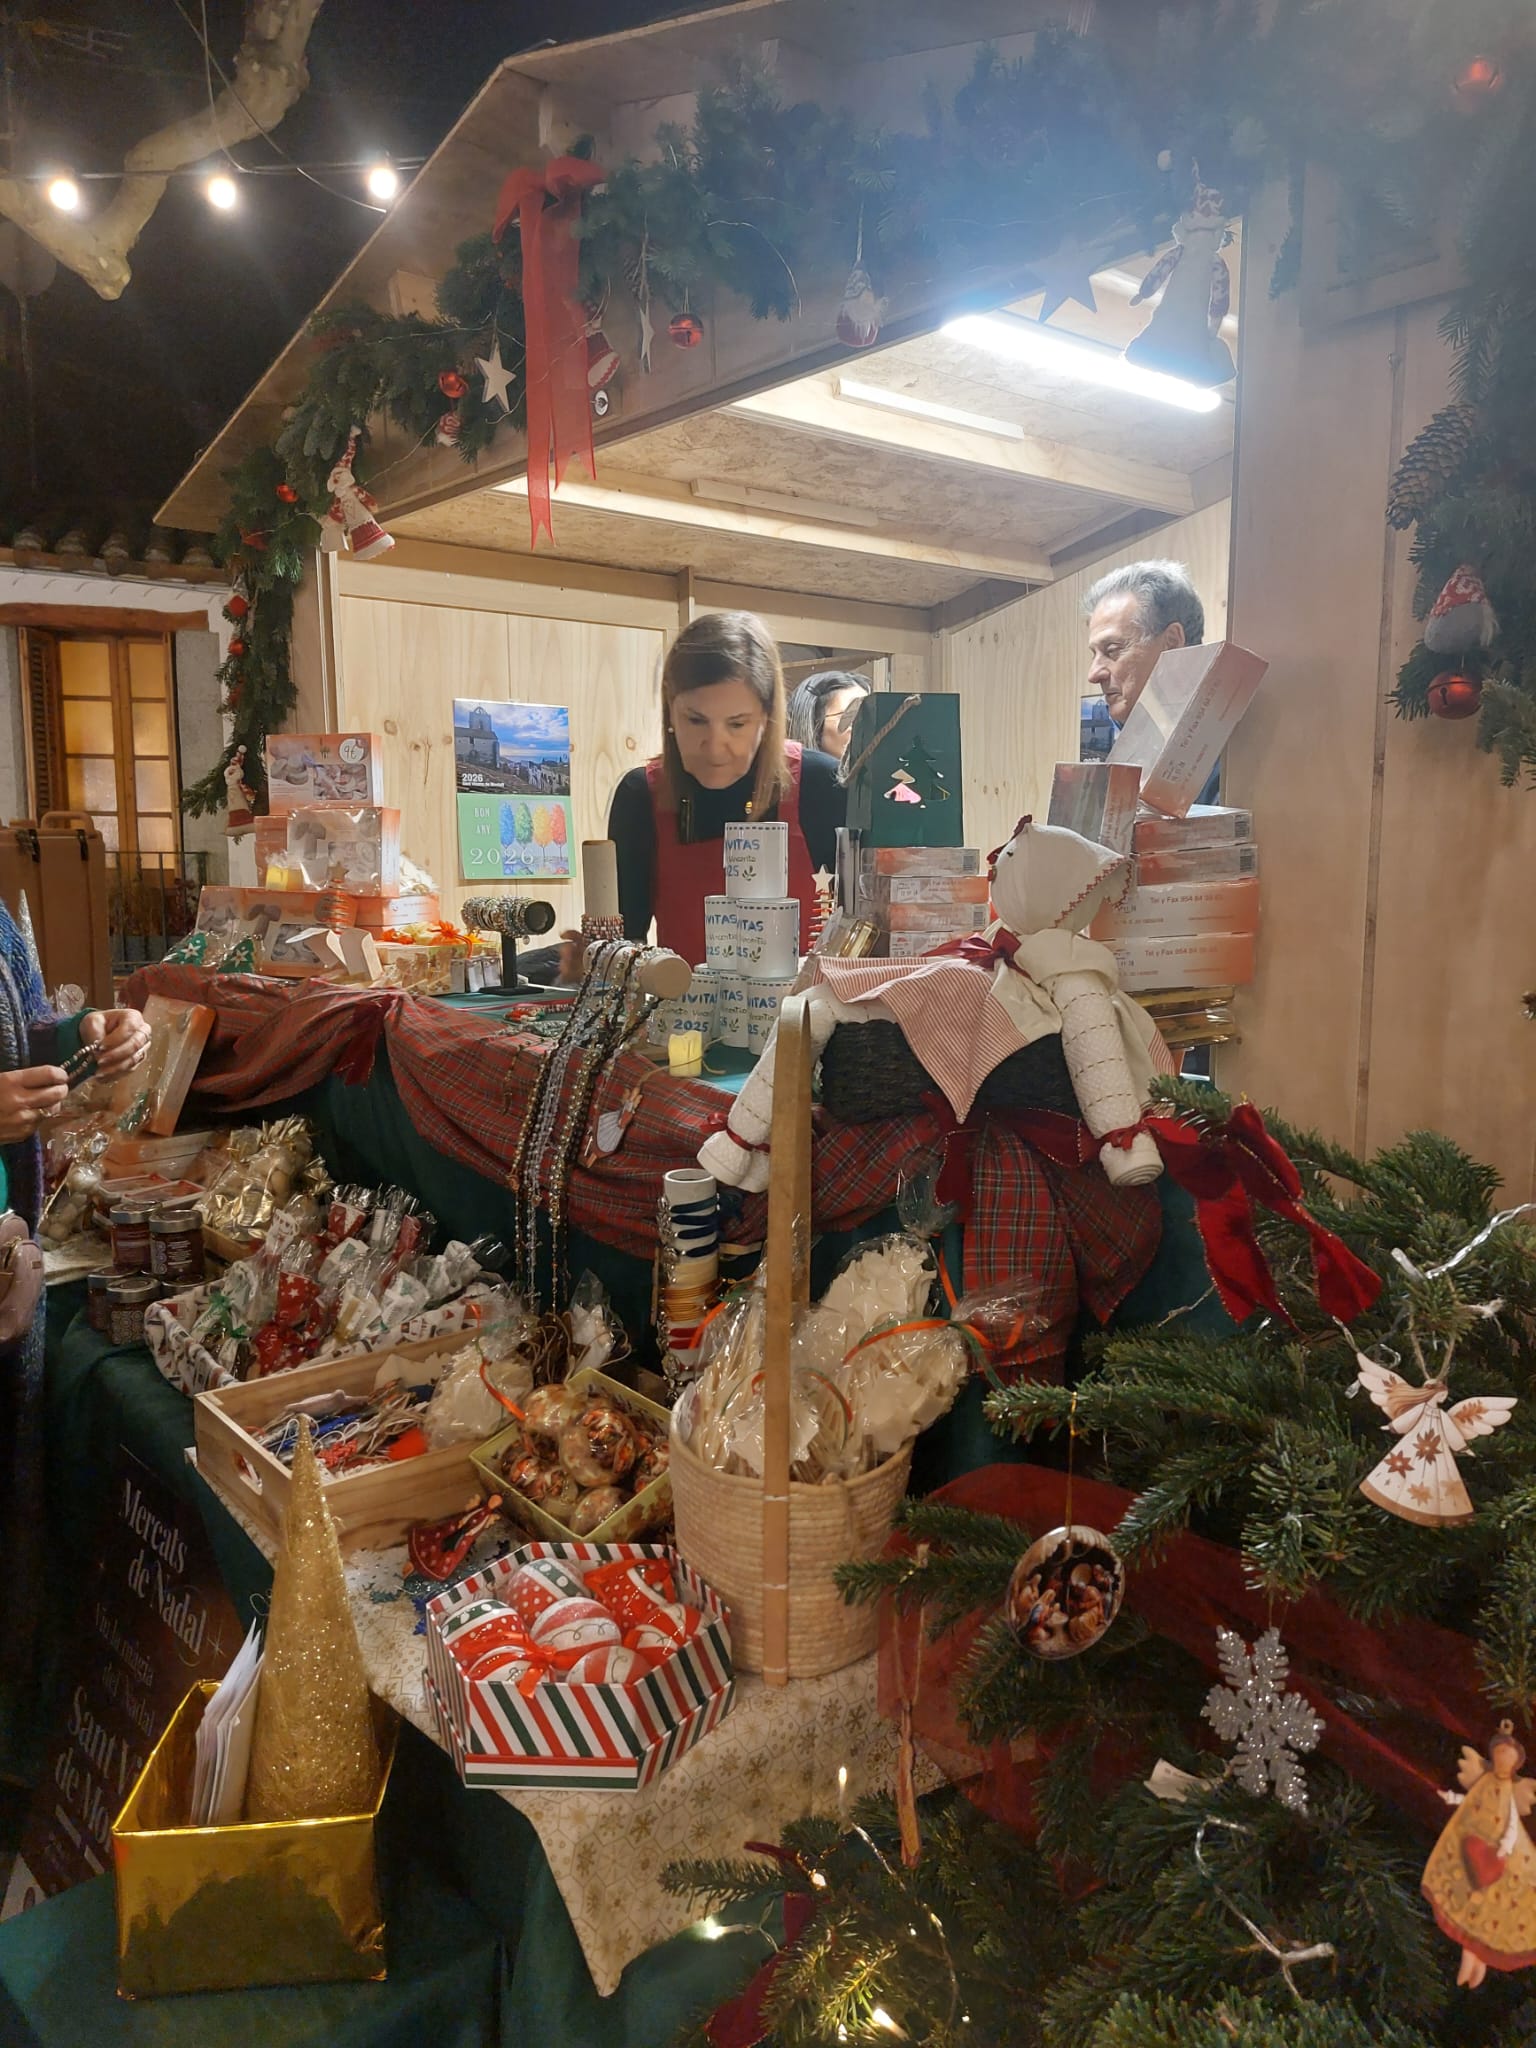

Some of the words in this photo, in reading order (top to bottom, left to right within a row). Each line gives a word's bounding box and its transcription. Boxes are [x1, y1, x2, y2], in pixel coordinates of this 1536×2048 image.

[462, 773, 484, 782] 2026
[470, 847, 534, 865] 2026
[727, 864, 739, 877] 25
[673, 1018, 709, 1033] 2025
[118, 1478, 188, 1574] Mercats
[128, 1548, 150, 1599] de
[150, 1560, 208, 1656] Nadal
[68, 1685, 117, 1779] Sant
